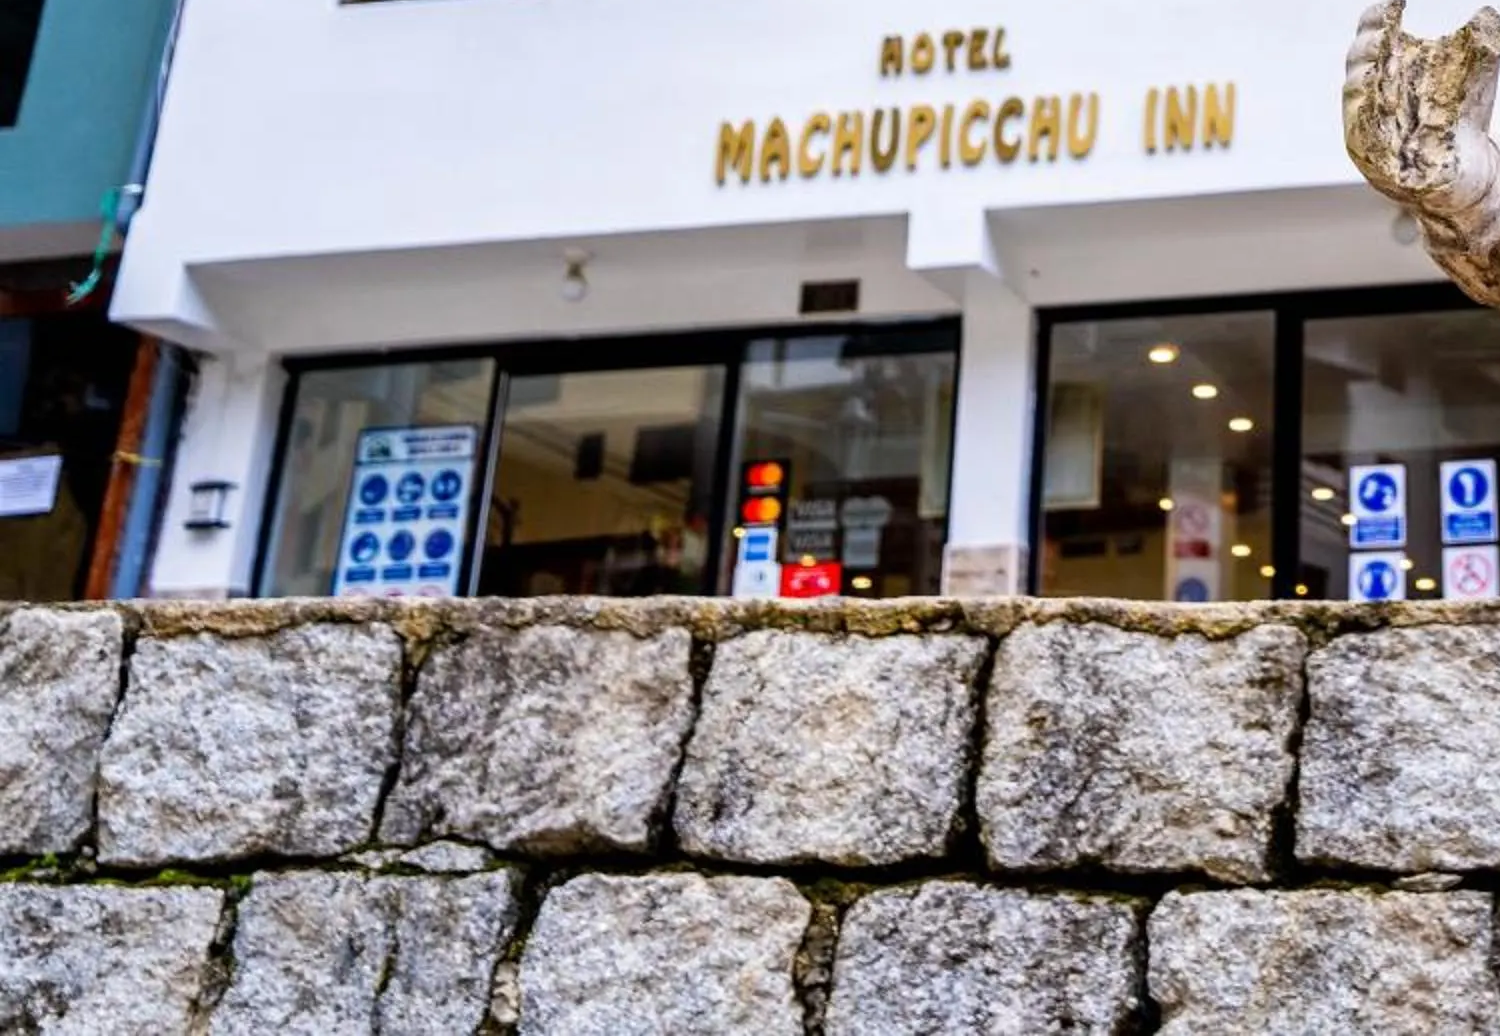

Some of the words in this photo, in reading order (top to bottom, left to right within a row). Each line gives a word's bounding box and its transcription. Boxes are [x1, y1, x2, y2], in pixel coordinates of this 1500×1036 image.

[880, 28, 1011, 77] HOTEL
[715, 92, 1099, 186] MACHUPICCHU
[1142, 81, 1236, 155] INN
